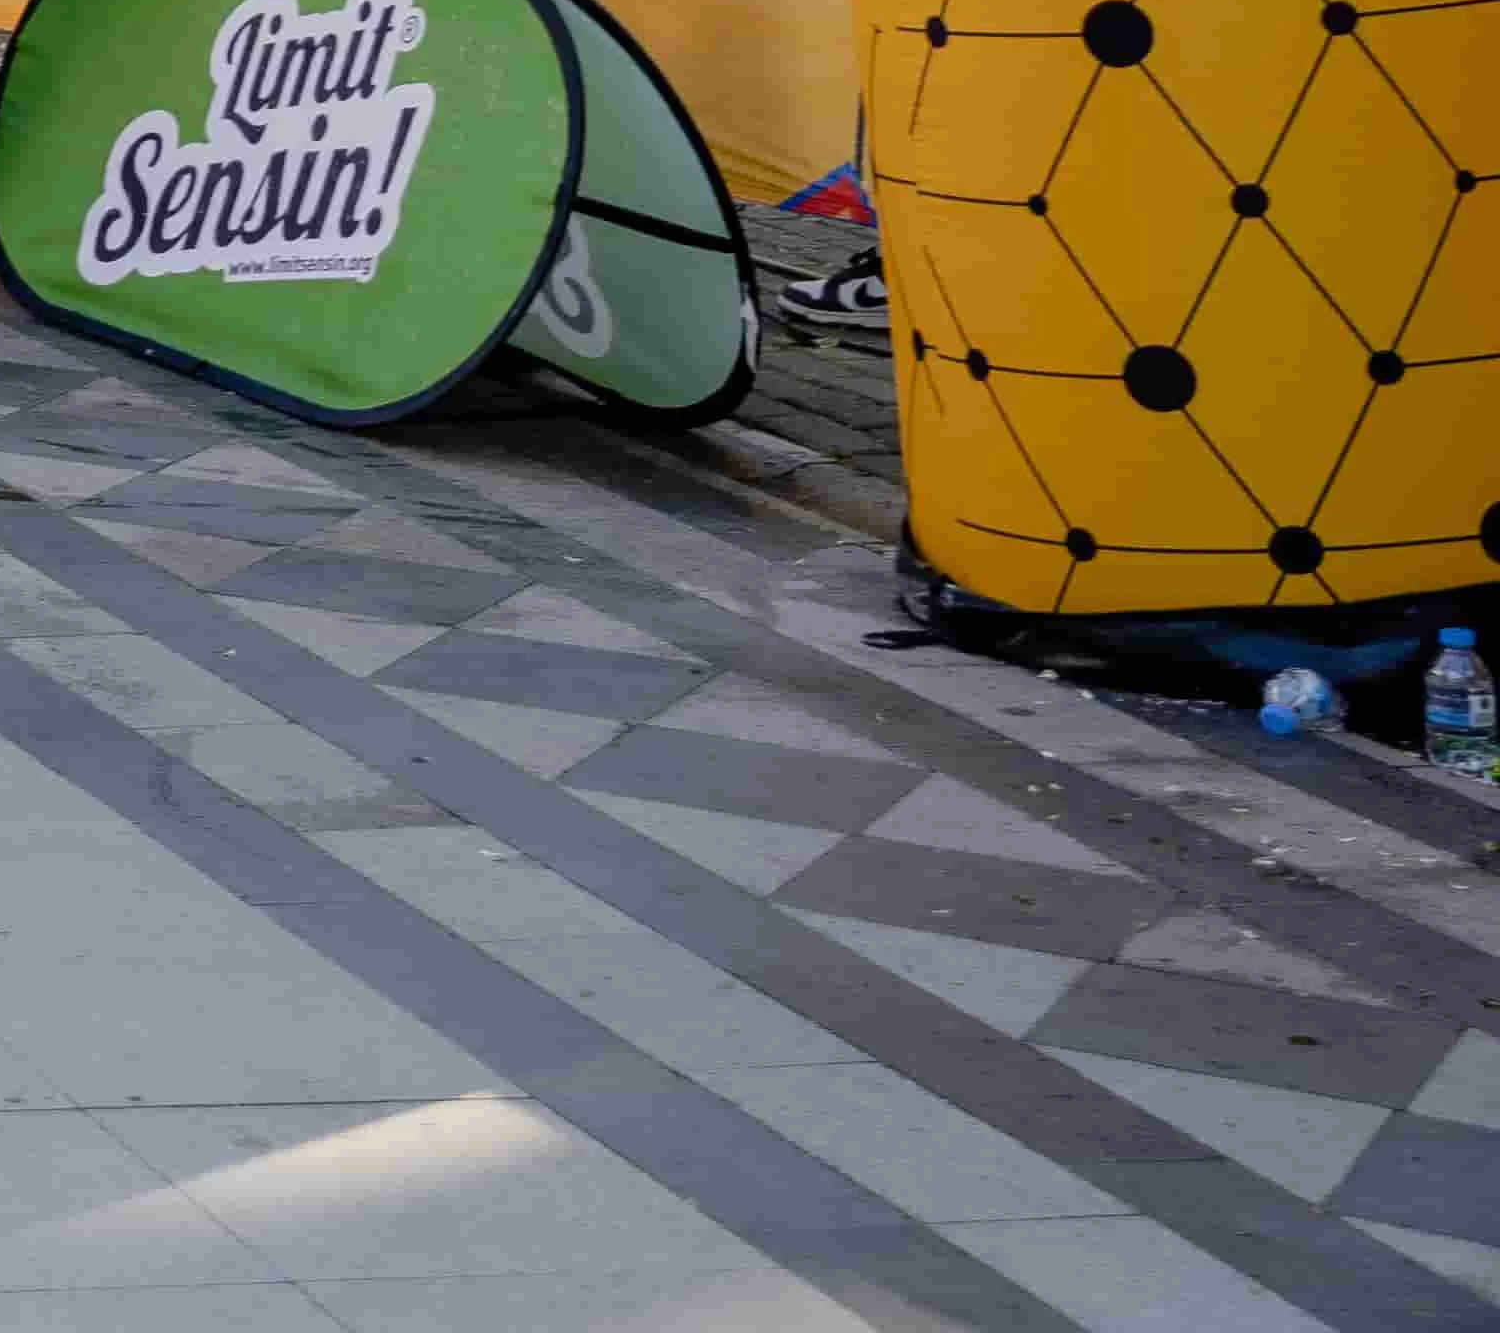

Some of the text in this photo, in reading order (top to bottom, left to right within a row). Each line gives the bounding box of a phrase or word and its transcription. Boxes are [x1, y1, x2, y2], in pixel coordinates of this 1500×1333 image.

[224, 0, 399, 144] Limit
[95, 106, 417, 264] Sensin!
[226, 252, 374, 279] www.limitsensin.org
